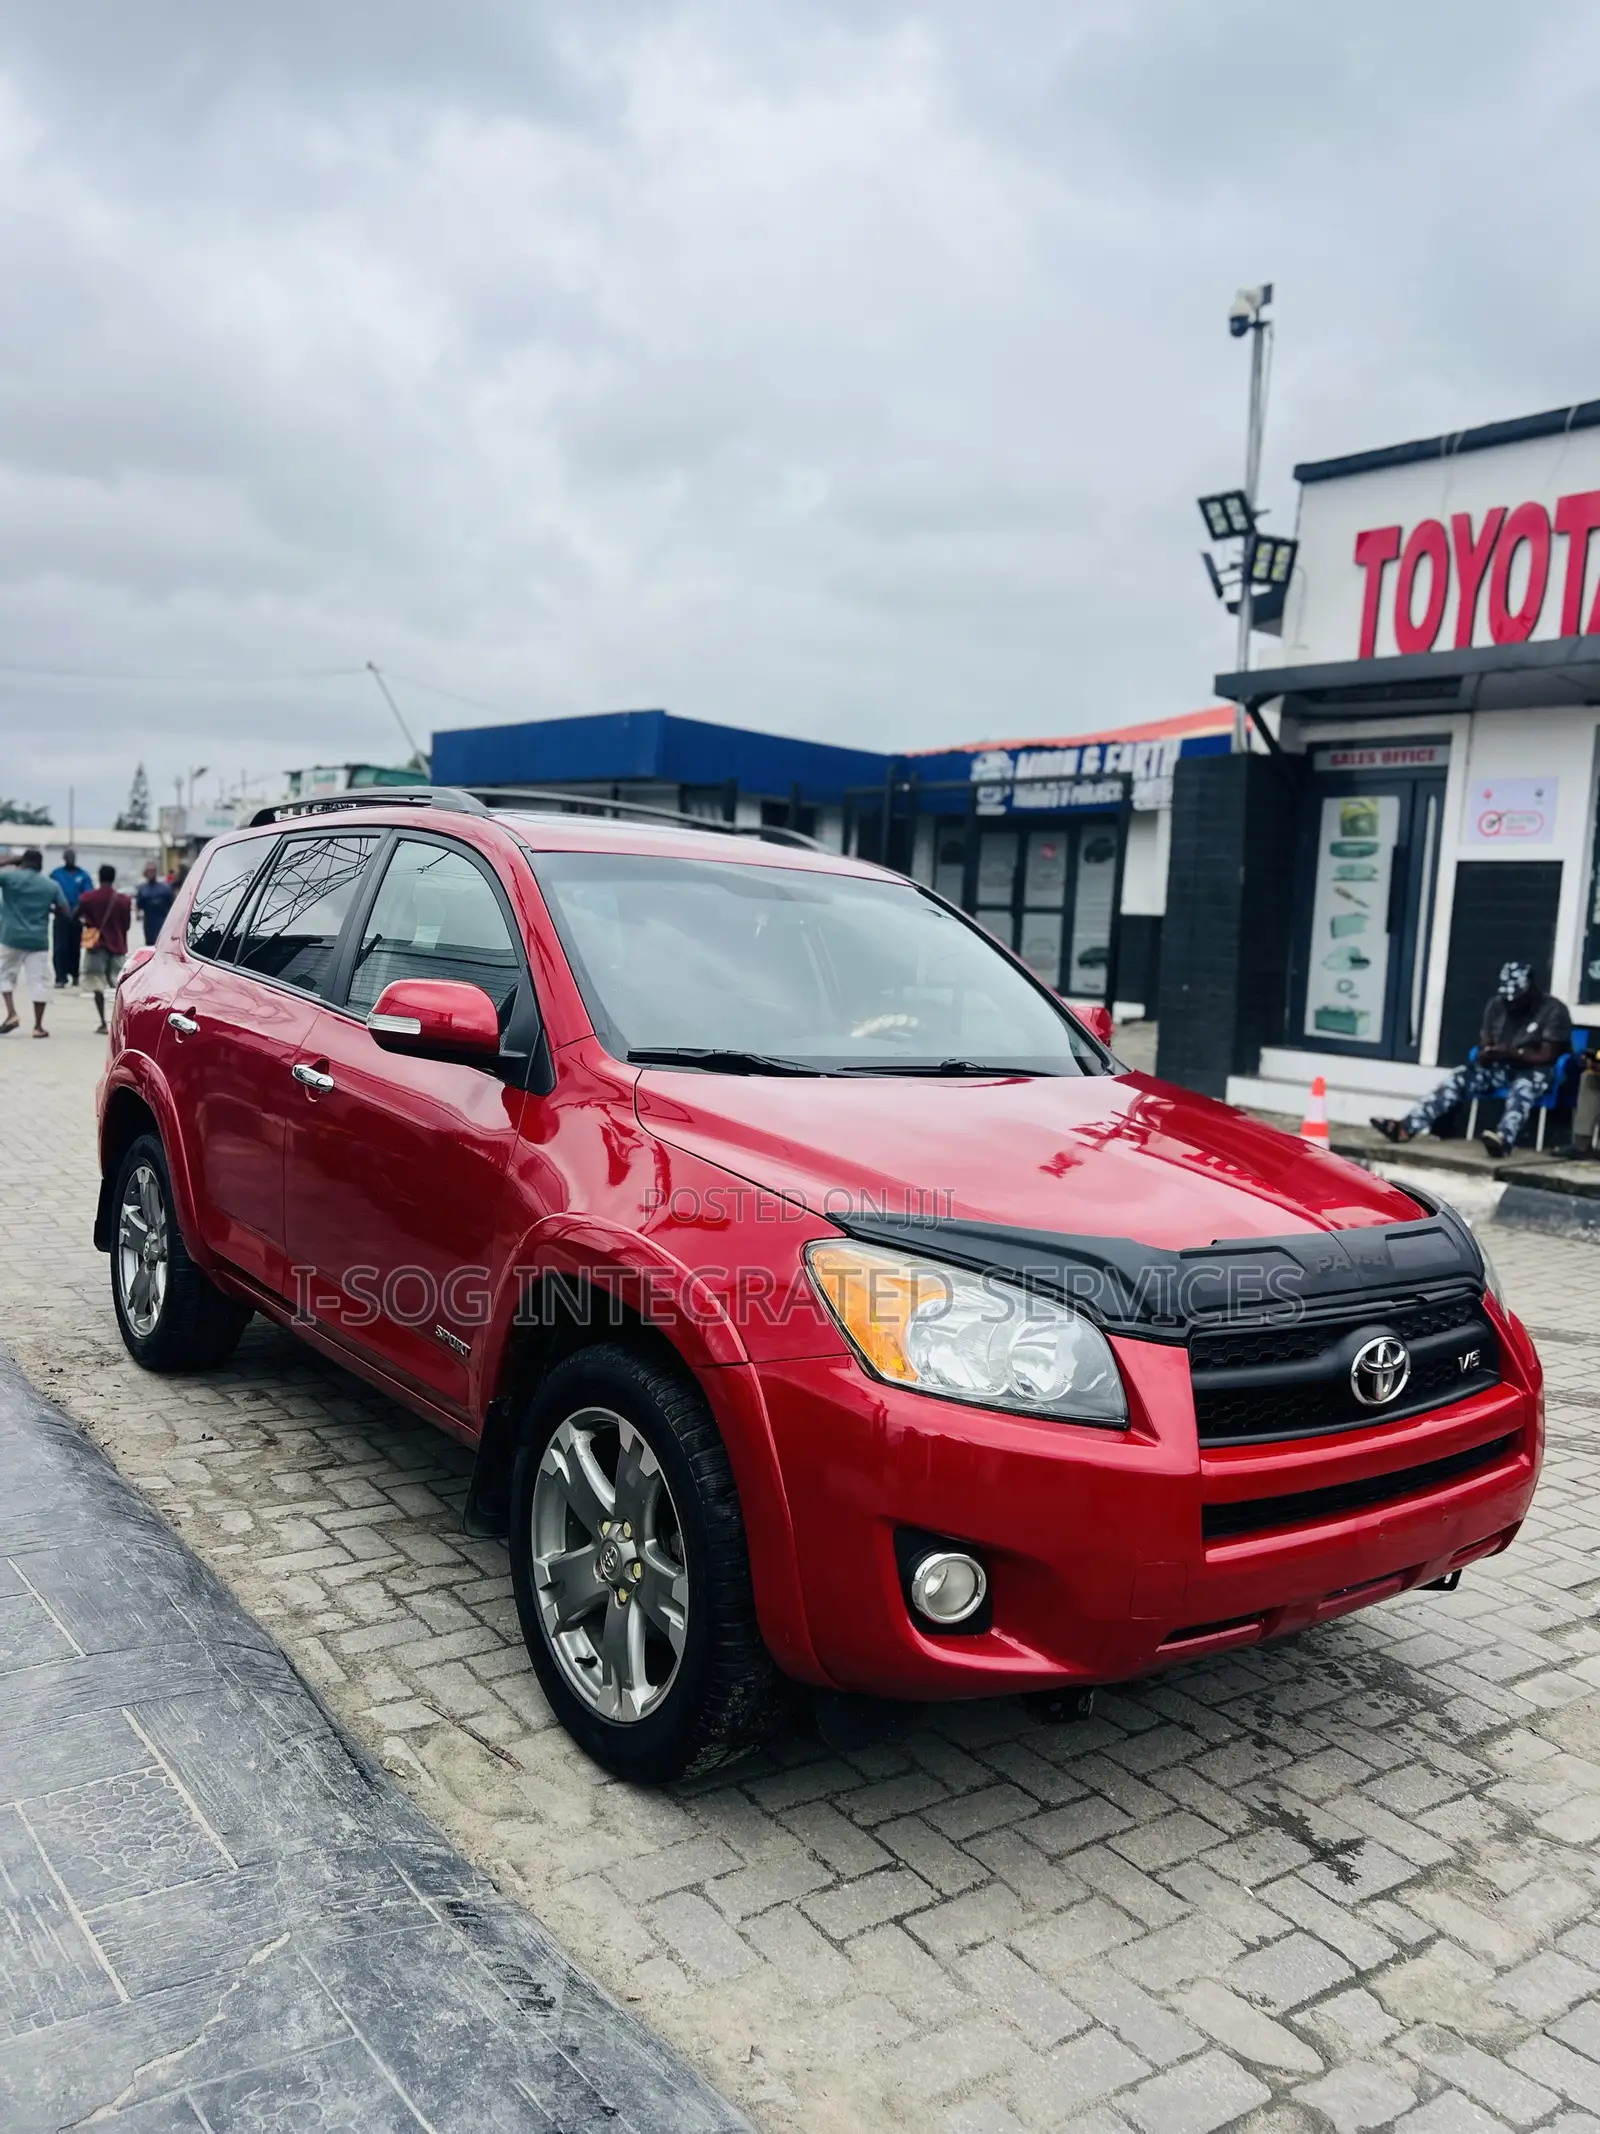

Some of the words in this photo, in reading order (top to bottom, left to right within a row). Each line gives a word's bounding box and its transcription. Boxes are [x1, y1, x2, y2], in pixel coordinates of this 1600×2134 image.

[1354, 490, 1600, 660] TOYOT
[1330, 750, 1377, 767] SALES
[1381, 747, 1438, 765] OFFICE
[435, 1324, 471, 1357] SPORT
[1457, 1349, 1481, 1373] V6
